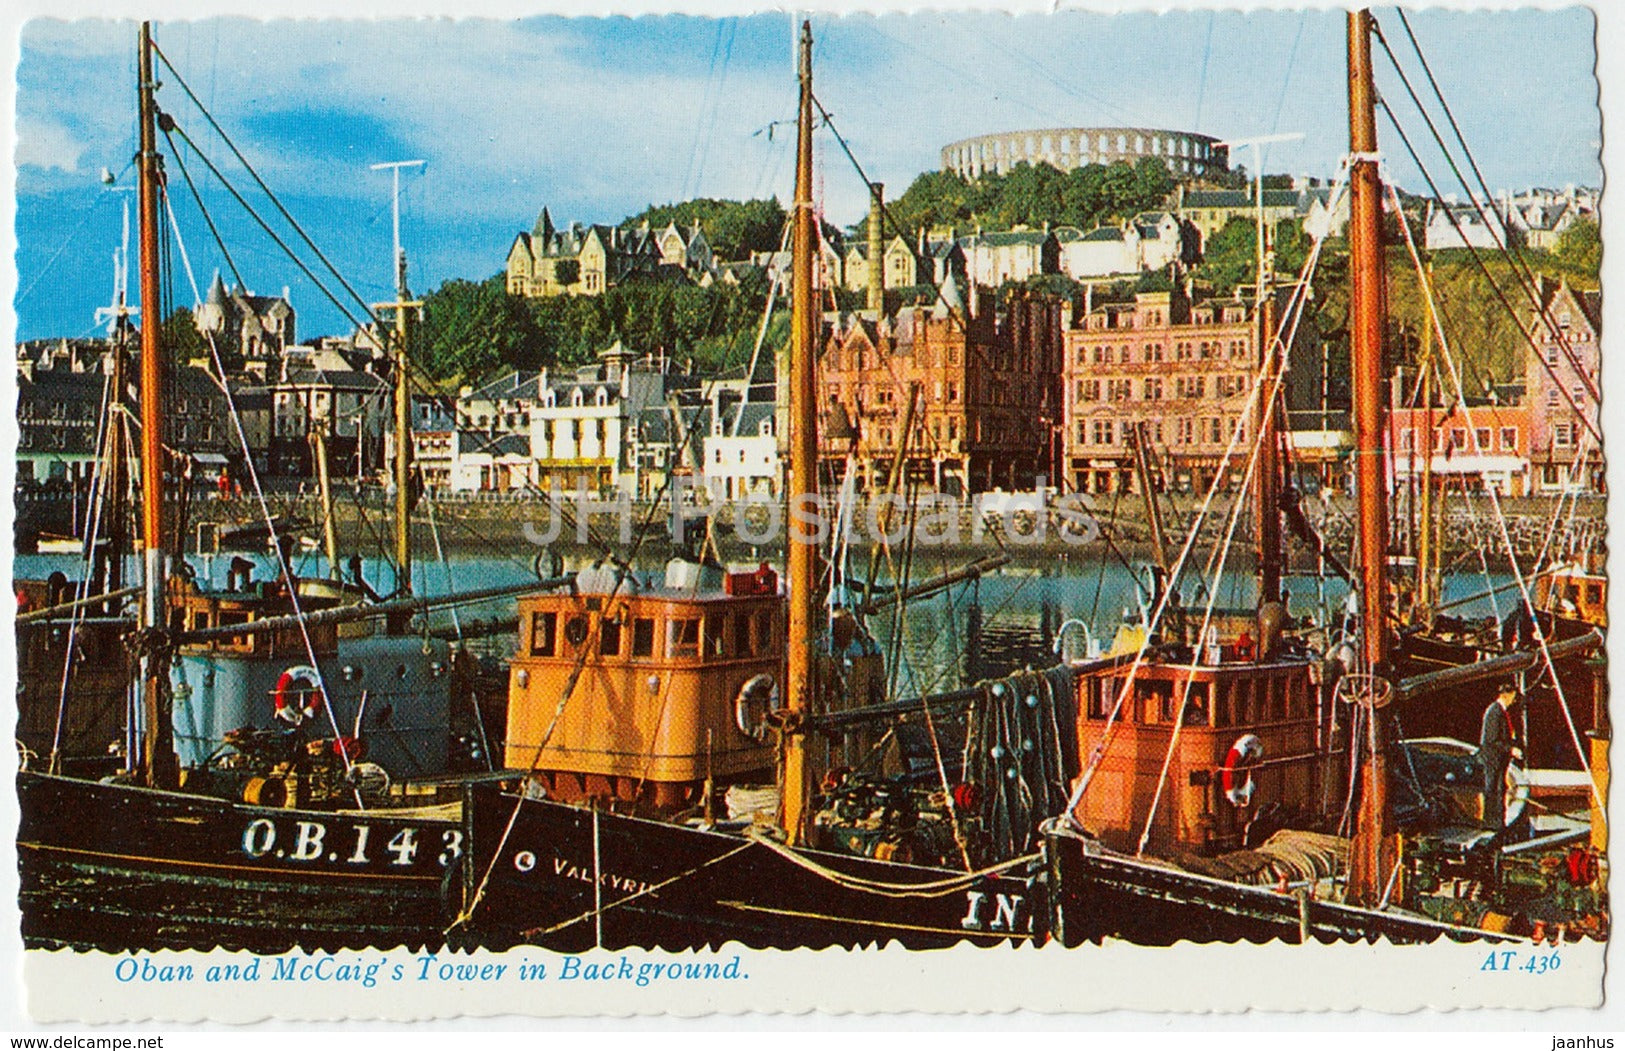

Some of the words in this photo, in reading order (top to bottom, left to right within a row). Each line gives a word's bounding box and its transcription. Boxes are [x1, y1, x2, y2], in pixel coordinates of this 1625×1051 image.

[114, 957, 193, 983] Oban
[205, 957, 260, 983] and
[271, 955, 403, 988] McCaig's
[417, 954, 508, 981] Tower
[518, 958, 547, 981] in
[558, 955, 750, 987] Background.
[1480, 949, 1562, 975] AT.436
